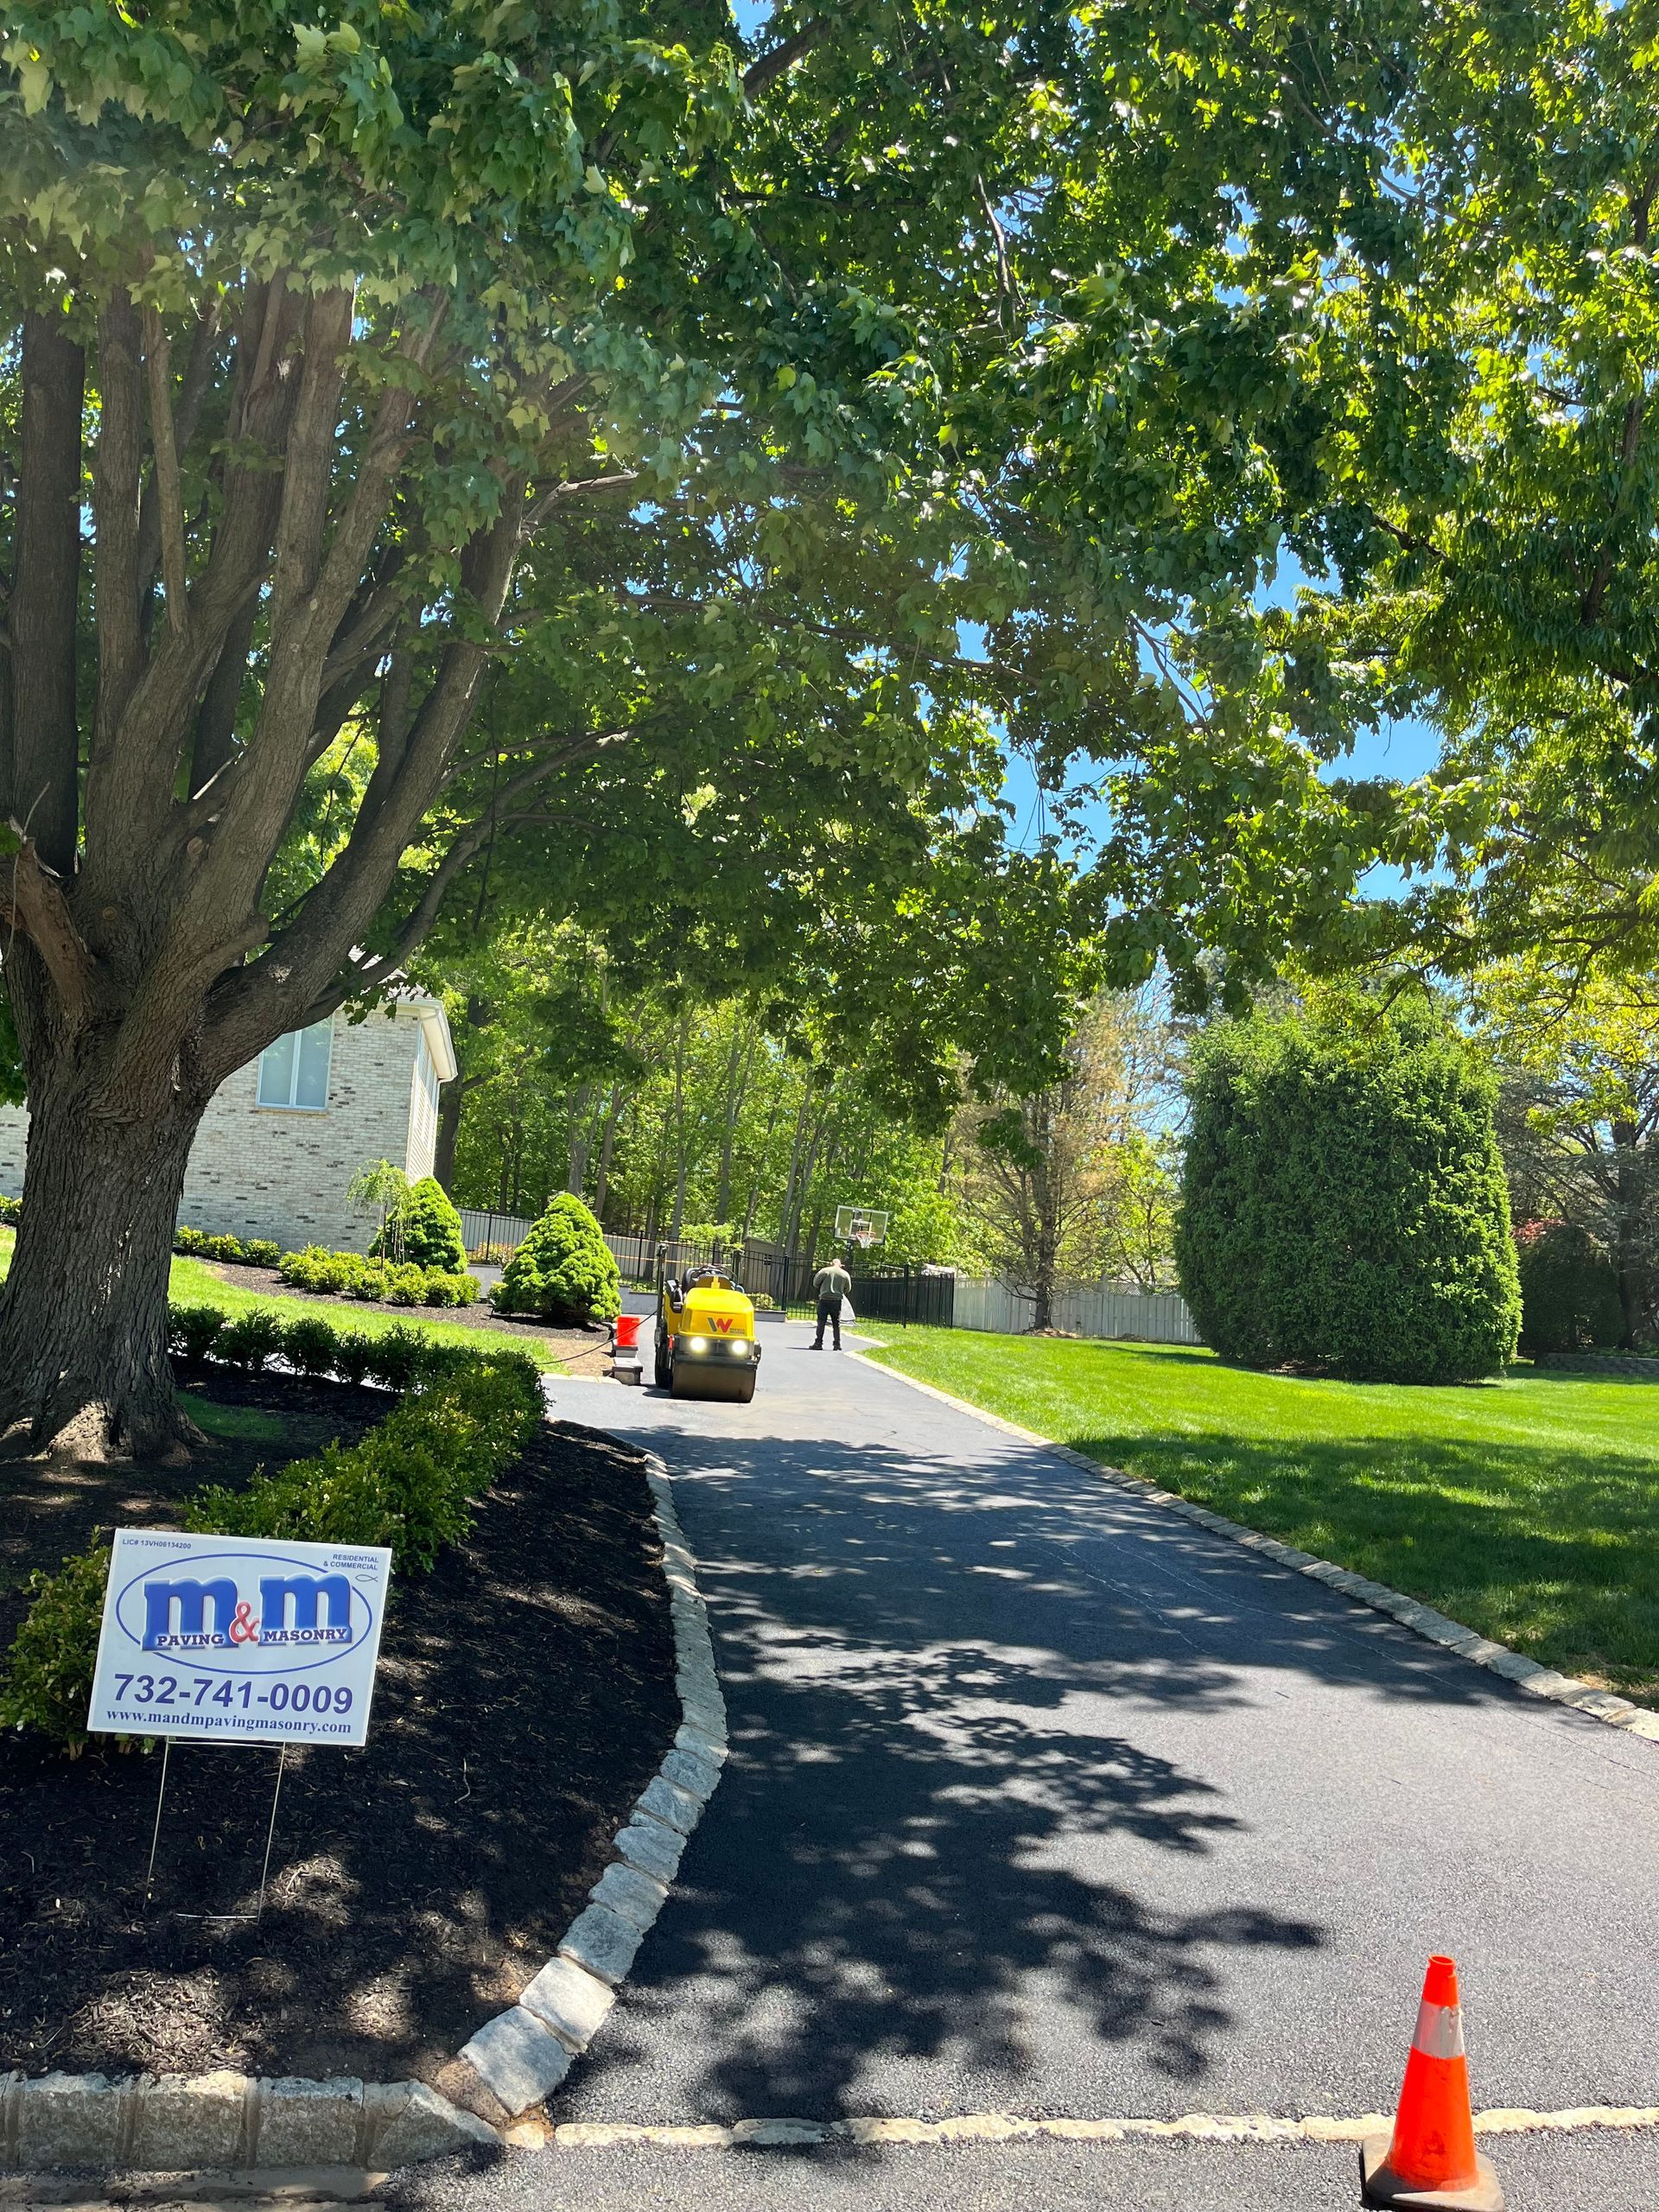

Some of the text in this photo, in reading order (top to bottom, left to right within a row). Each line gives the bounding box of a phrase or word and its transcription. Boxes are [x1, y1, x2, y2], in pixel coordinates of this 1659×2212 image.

[330, 1561, 378, 1570] COMMERCIAL
[333, 1554, 378, 1563] RESIDENTIAL
[157, 1628, 347, 1646] PAVING MASONRY
[114, 1674, 353, 1714] 732-741-0009
[106, 1710, 352, 1733] www.mandmpavingmasonry.com
